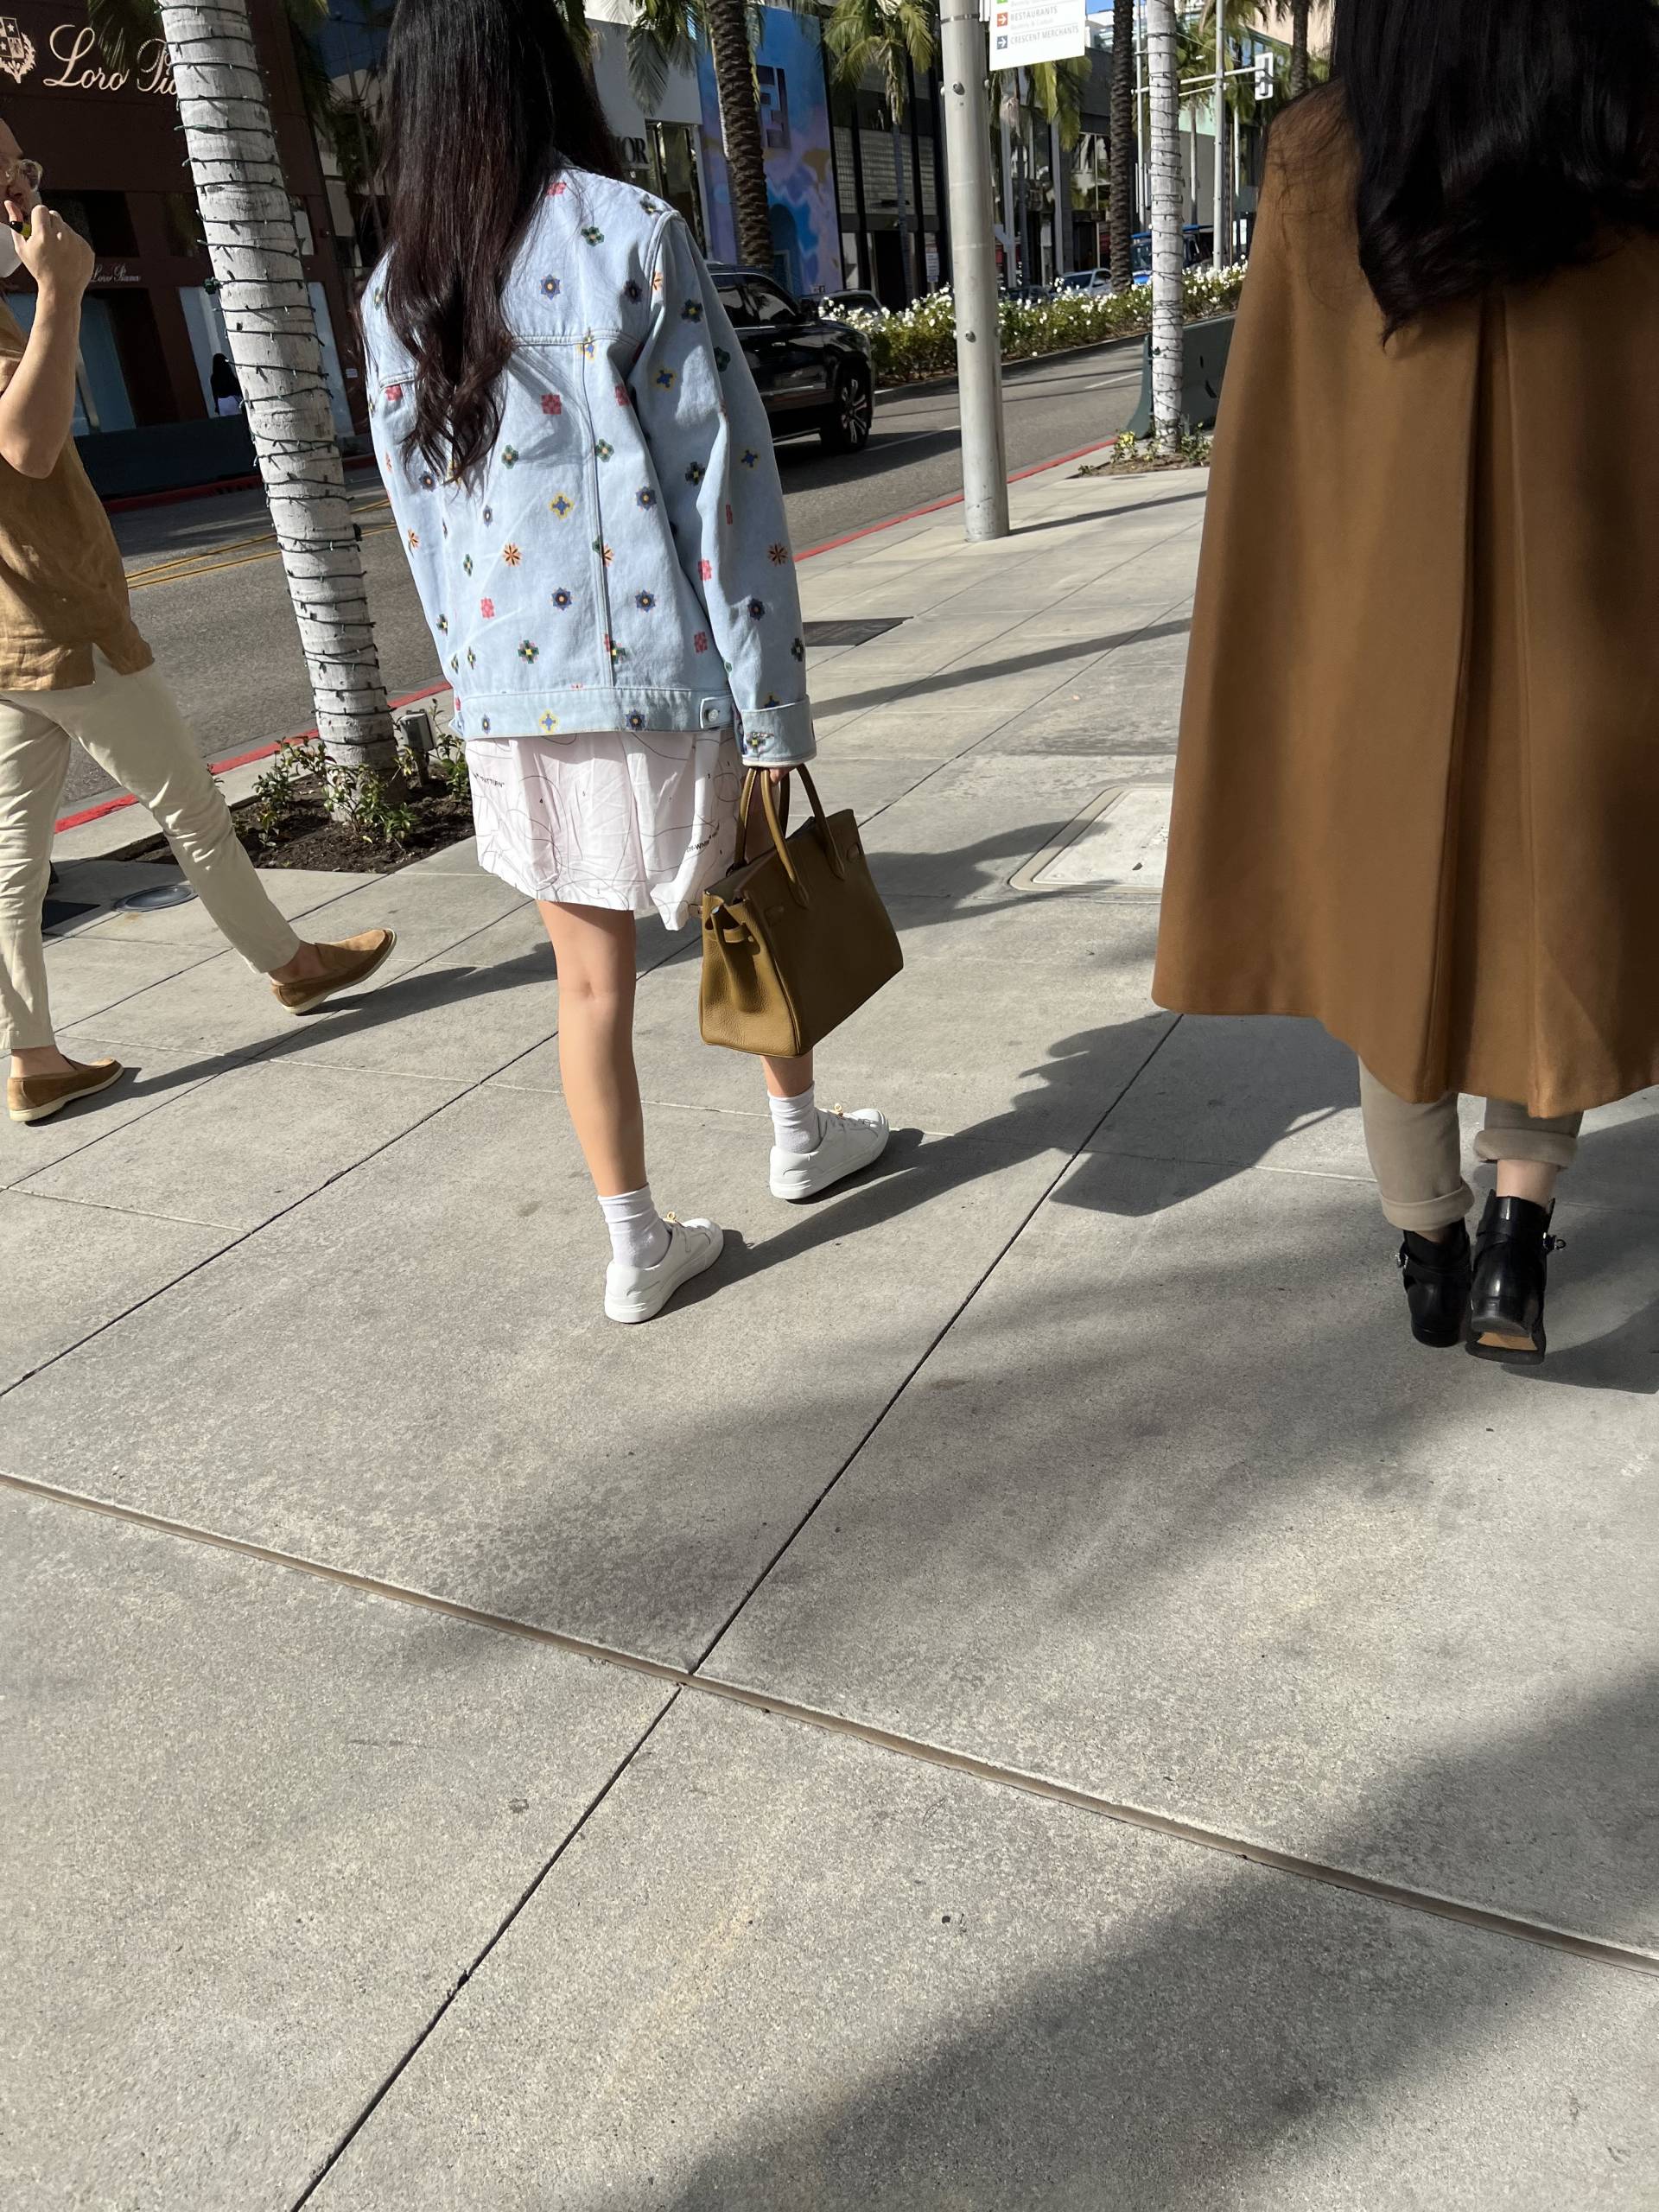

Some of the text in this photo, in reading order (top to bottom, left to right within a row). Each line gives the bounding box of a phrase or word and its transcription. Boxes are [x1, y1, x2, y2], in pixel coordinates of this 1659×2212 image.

[1010, 5, 1058, 21] RESTAURANTS
[1010, 25, 1079, 44] CRESCENT MERCHANTS
[42, 24, 130, 91] Loro
